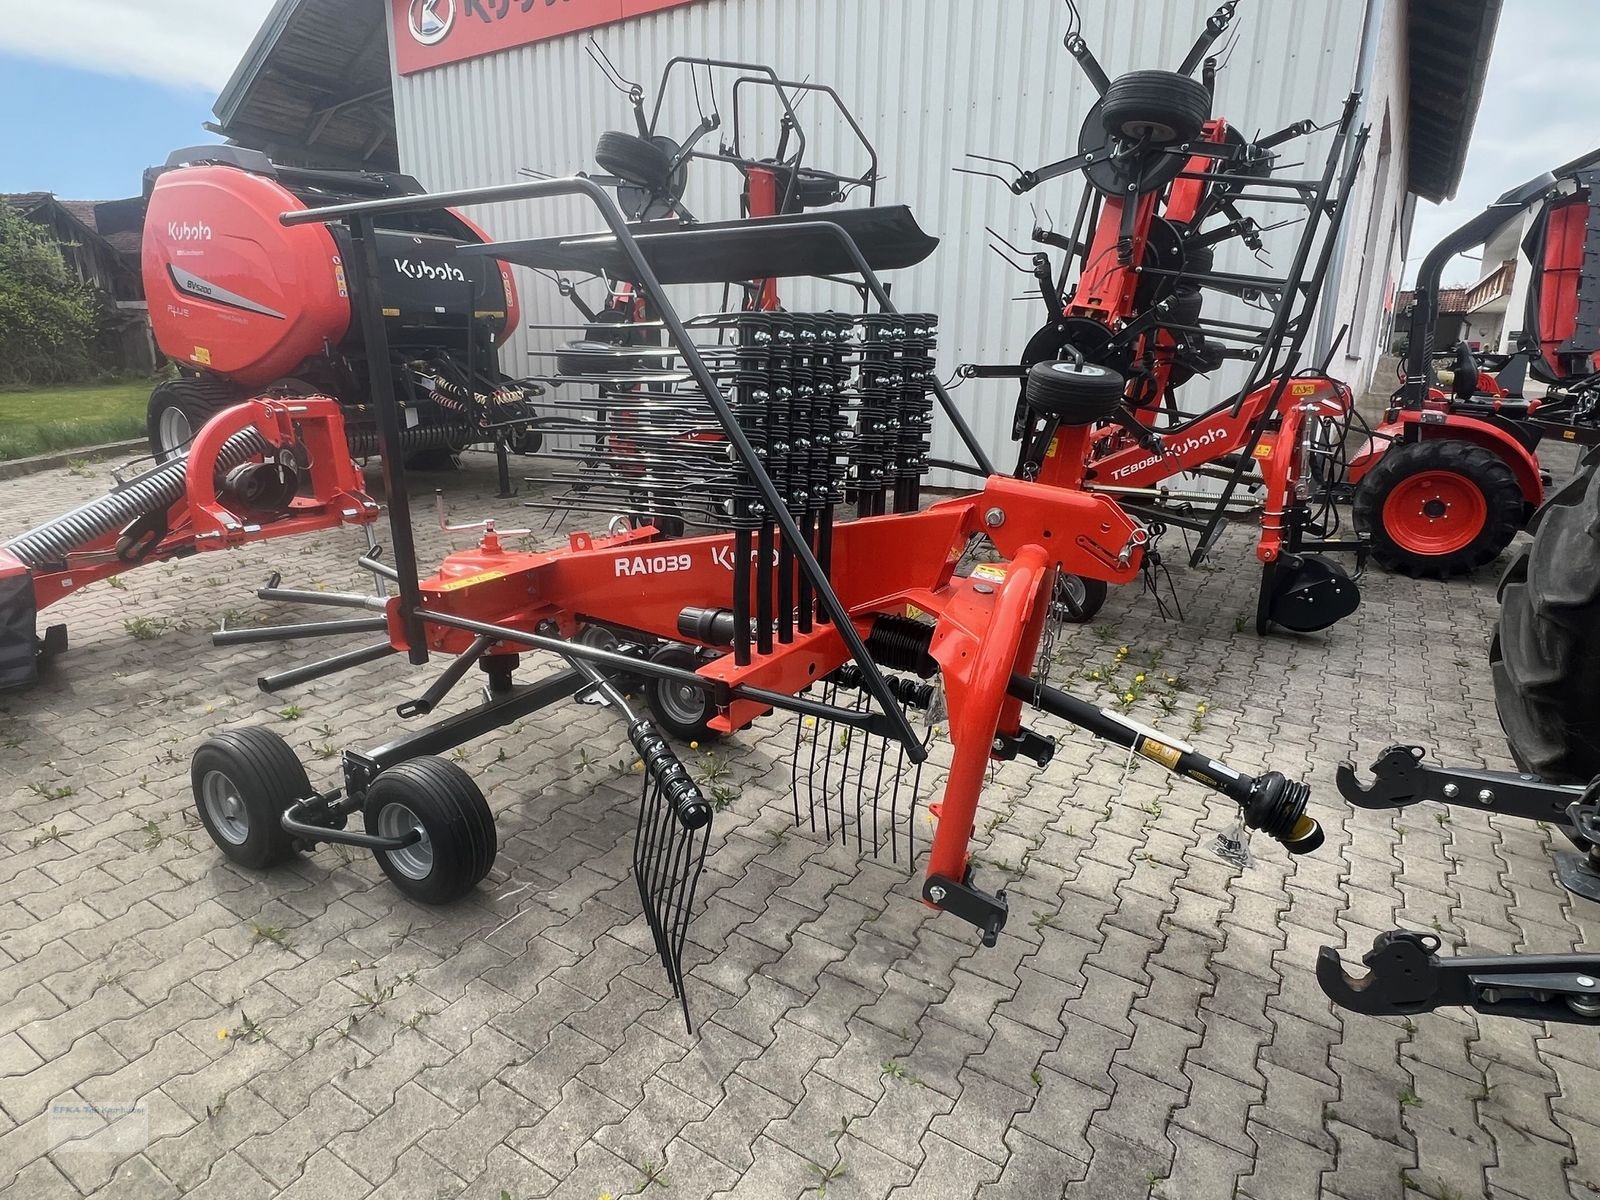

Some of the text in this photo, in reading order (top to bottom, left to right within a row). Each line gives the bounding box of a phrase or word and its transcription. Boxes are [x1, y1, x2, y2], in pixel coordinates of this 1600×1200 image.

[168, 221, 212, 241] Kubota
[394, 258, 465, 282] Kubota
[186, 280, 212, 295] BV5200
[1164, 428, 1228, 458] Kubota
[614, 554, 692, 577] RA1039
